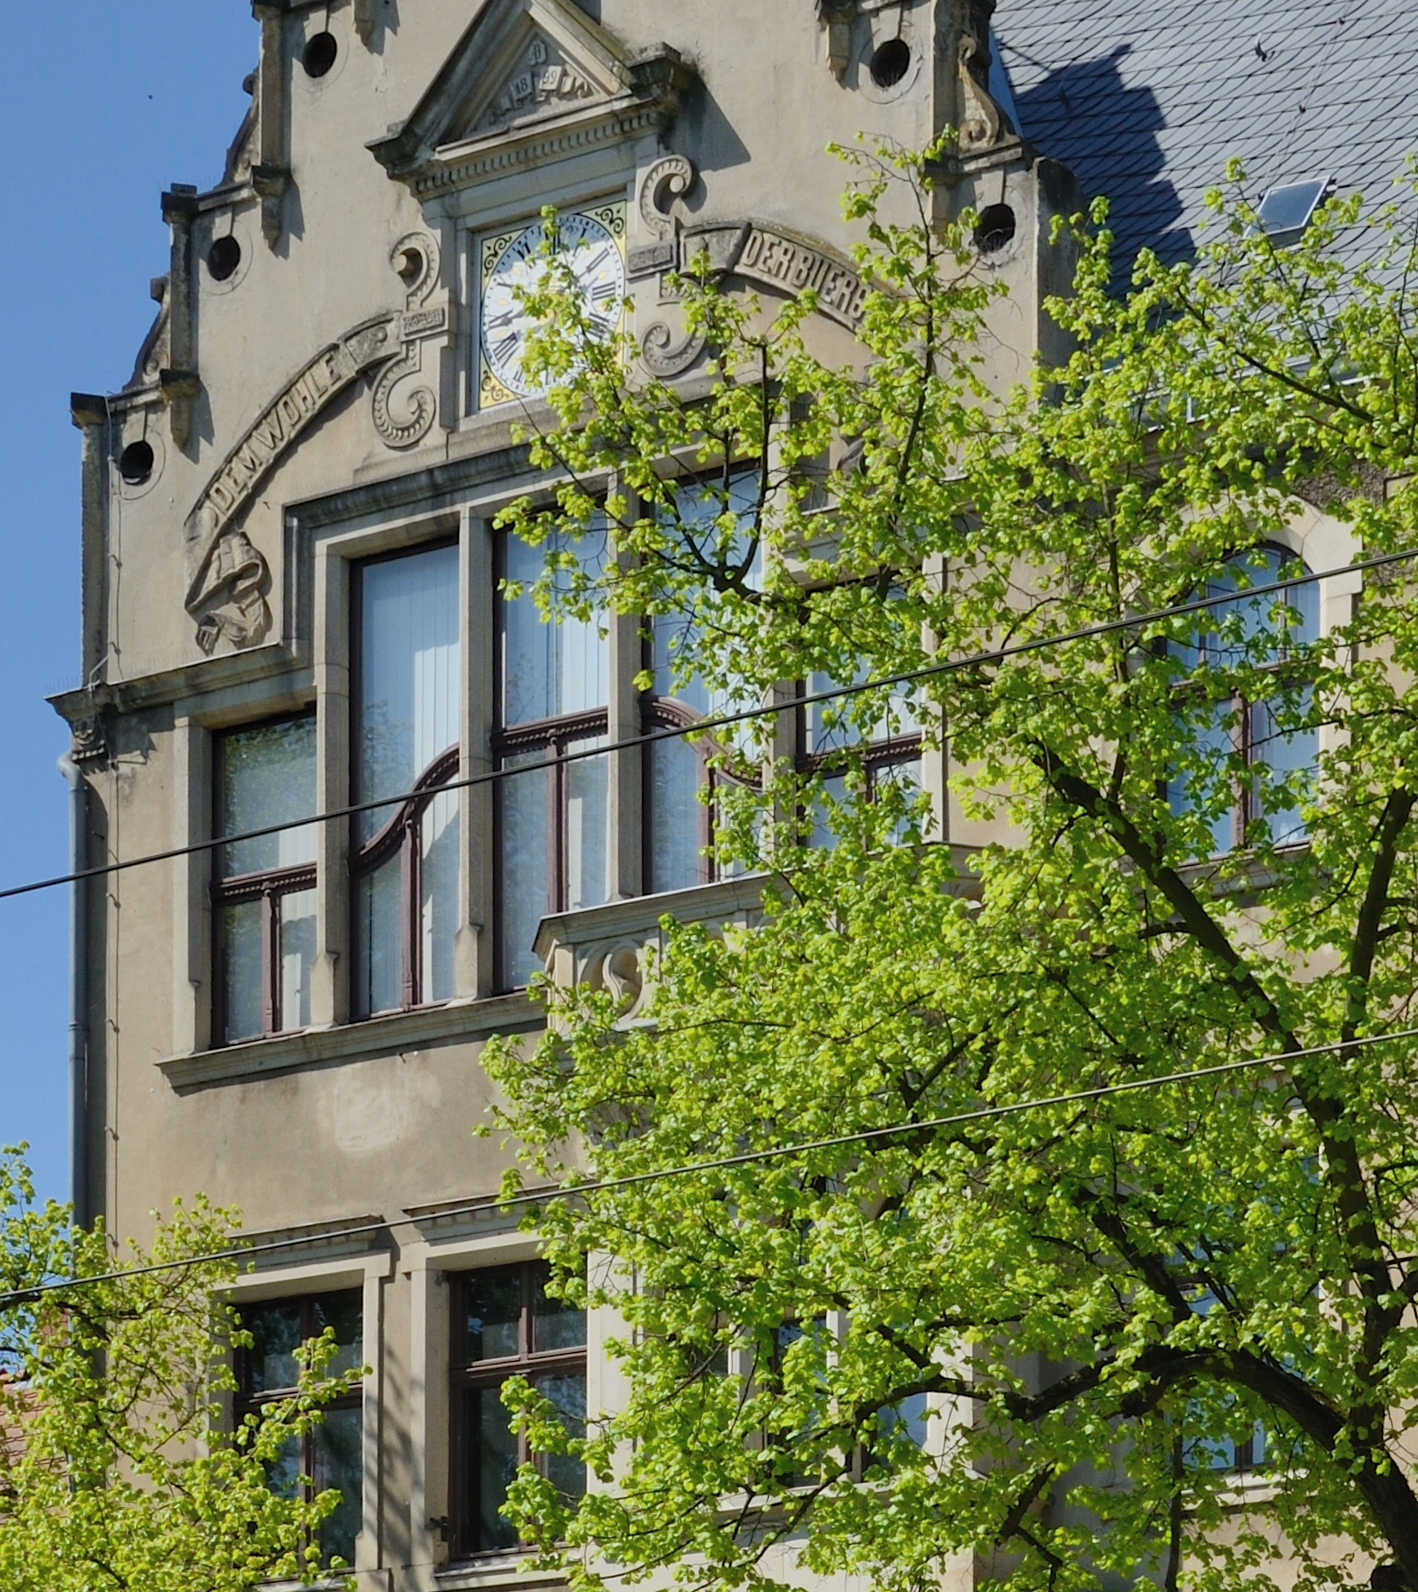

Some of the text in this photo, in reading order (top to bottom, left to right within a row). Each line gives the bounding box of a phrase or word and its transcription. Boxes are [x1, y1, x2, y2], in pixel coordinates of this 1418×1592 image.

[740, 228, 797, 281] DER
[208, 351, 344, 517] DEM WOHLE
